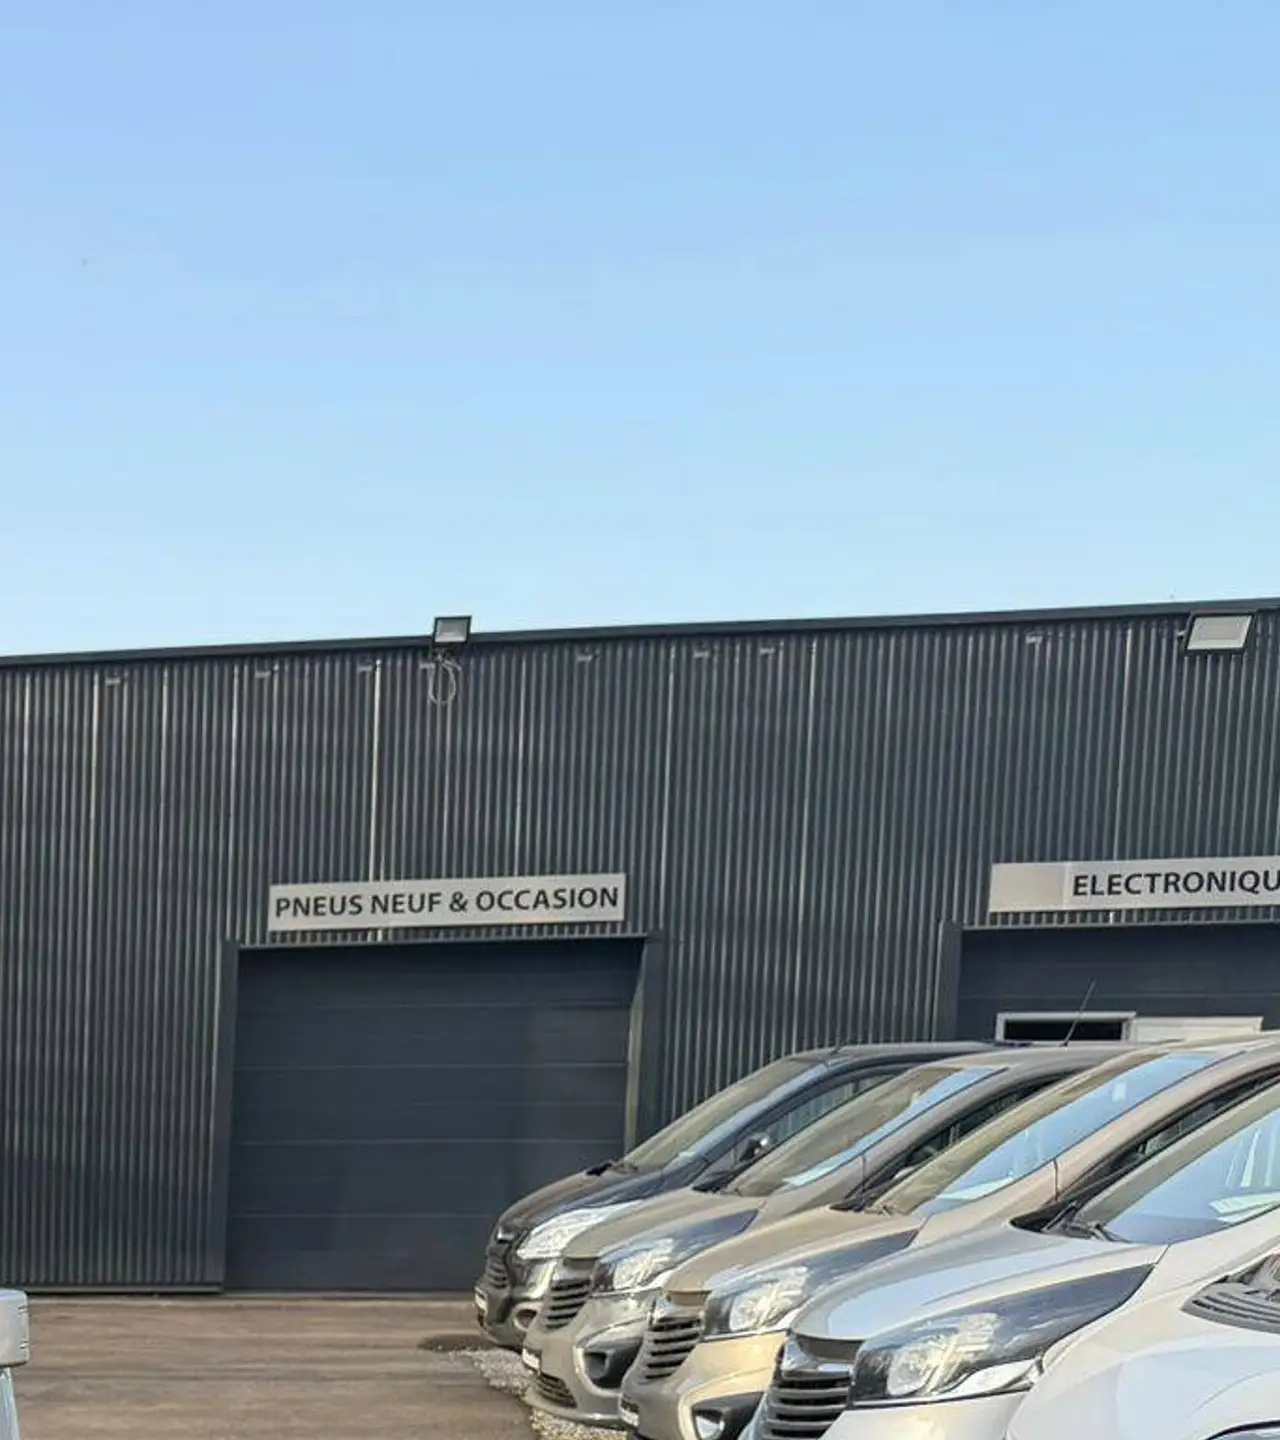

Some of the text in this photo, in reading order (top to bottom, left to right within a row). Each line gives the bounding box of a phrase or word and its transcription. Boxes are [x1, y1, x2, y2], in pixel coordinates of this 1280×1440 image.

[274, 886, 619, 918] PNEUS NEUF & OCCASION
